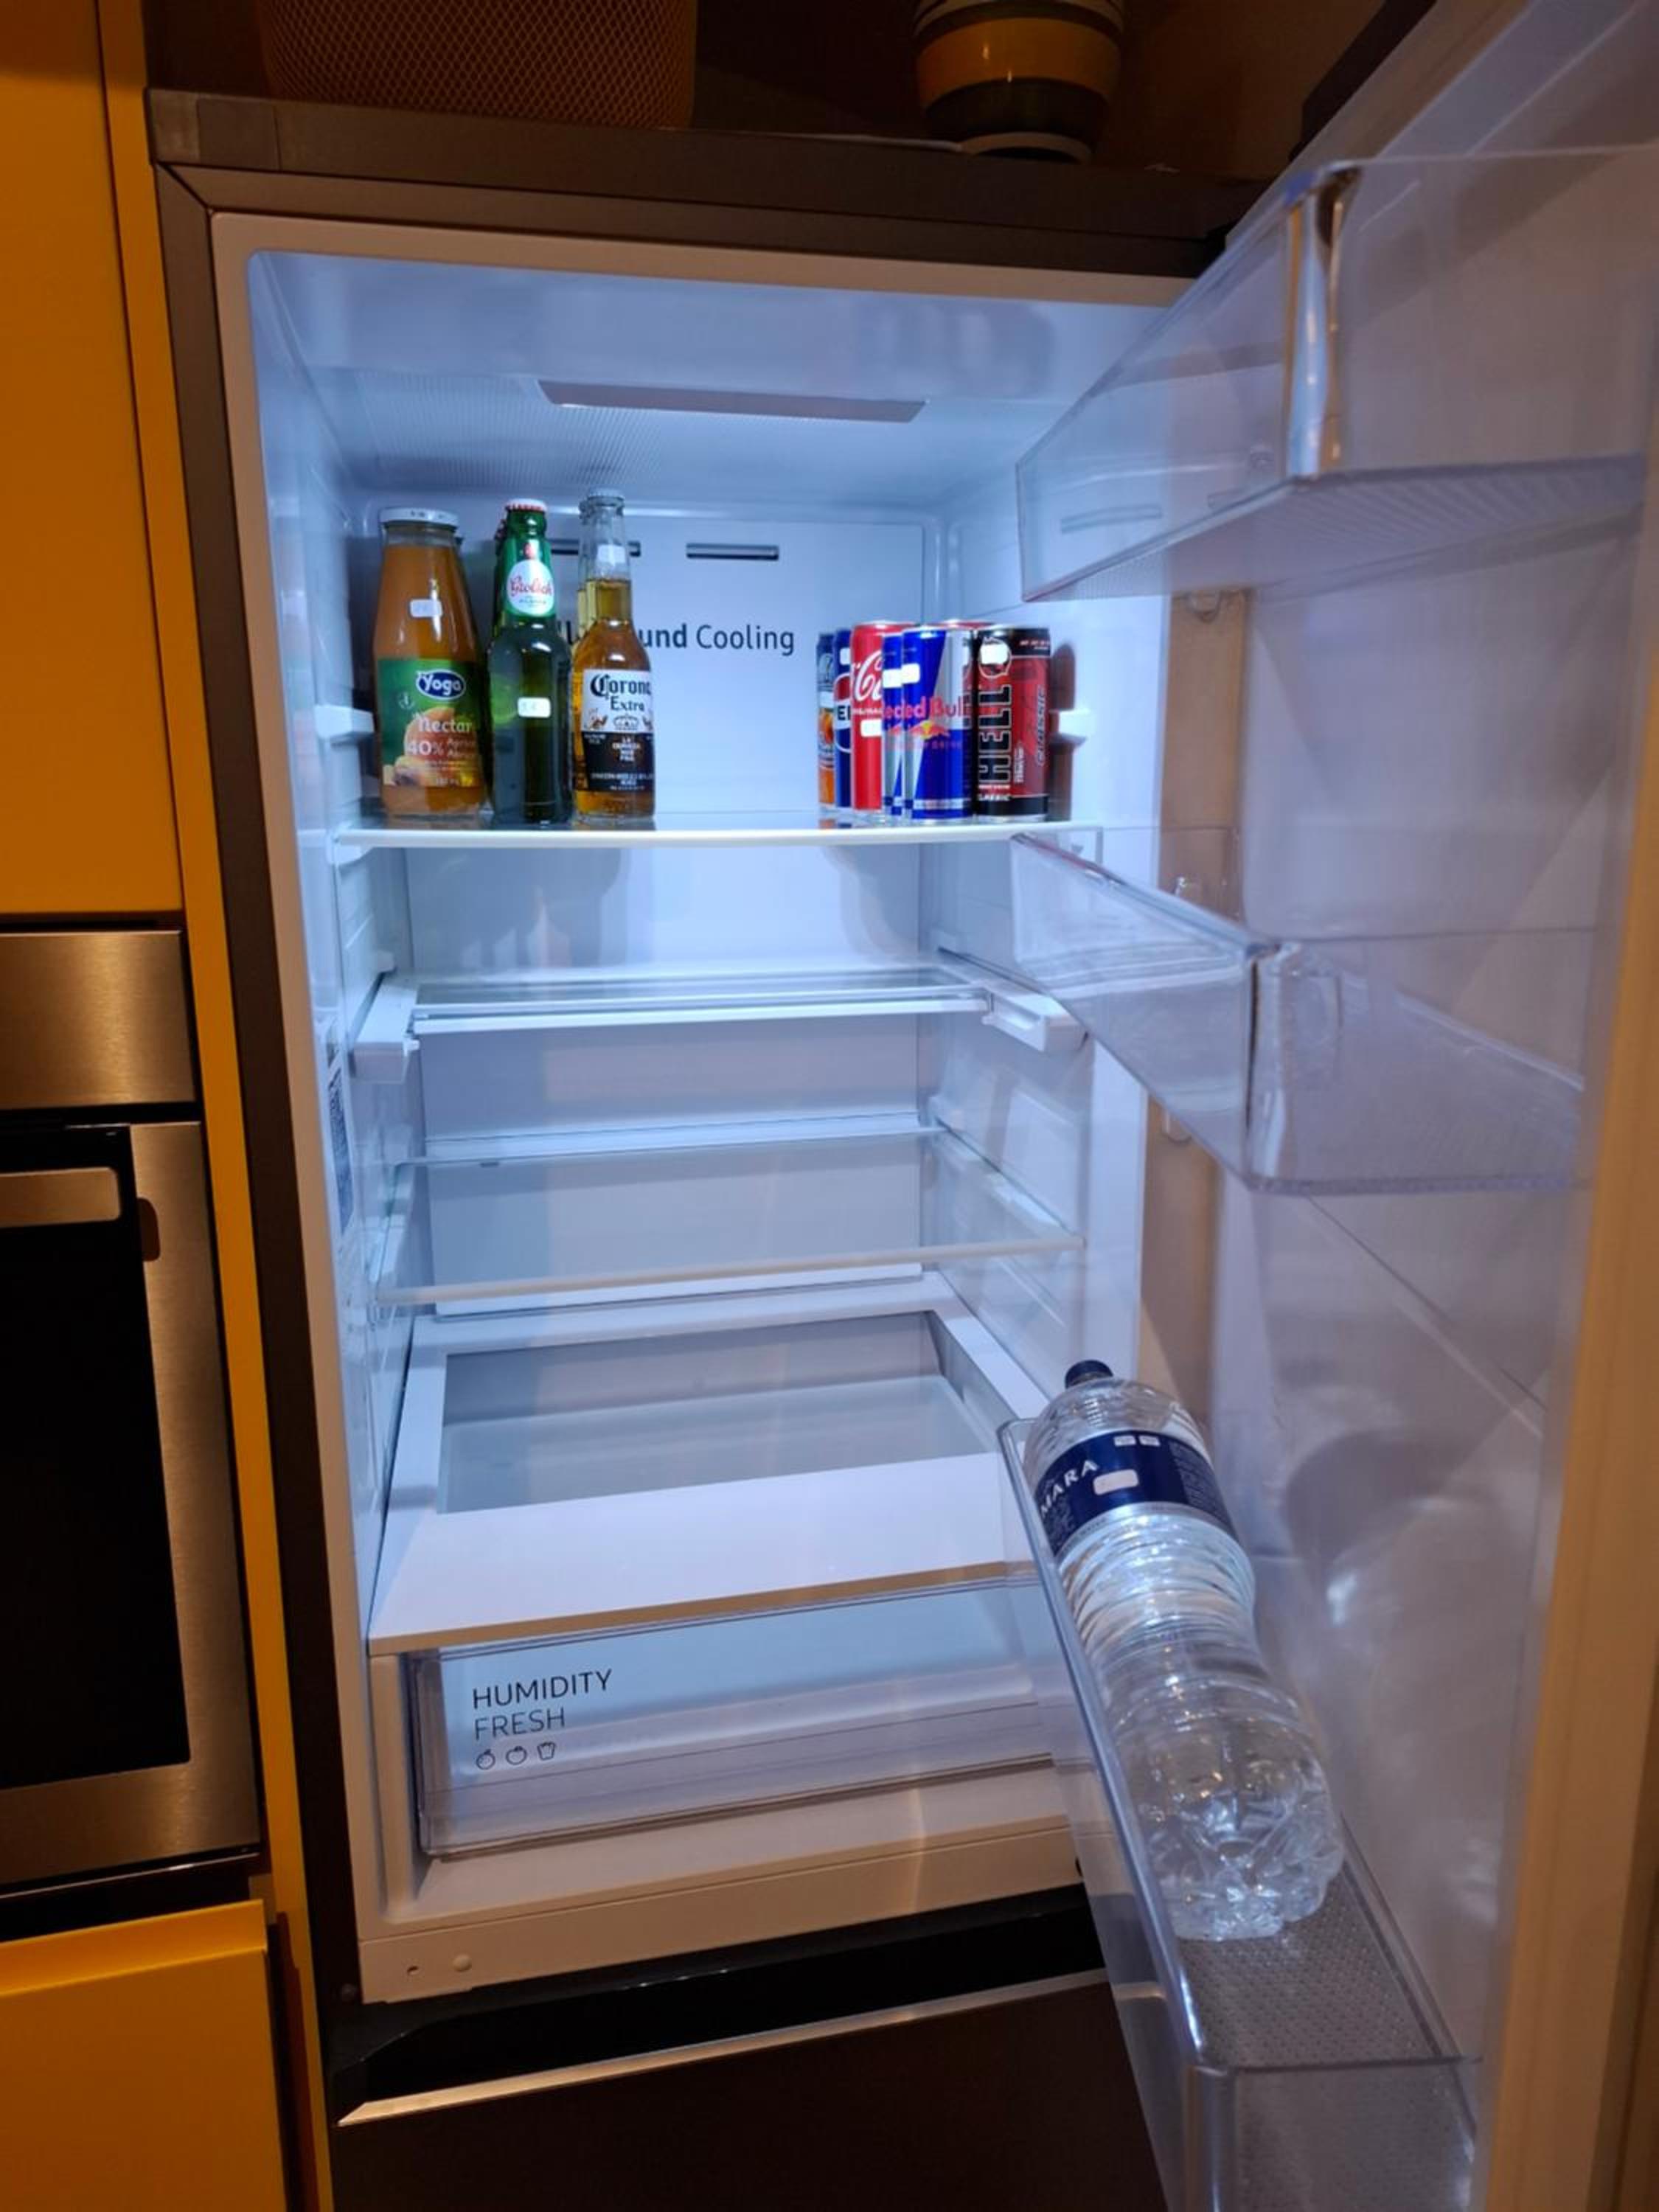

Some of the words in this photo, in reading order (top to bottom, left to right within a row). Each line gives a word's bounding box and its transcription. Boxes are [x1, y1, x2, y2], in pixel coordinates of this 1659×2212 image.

[509, 574, 552, 597] Grolsch
[638, 622, 687, 649] und
[696, 624, 795, 656] Cooling
[421, 672, 462, 696] Yoga
[610, 695, 645, 712] Extra
[978, 684, 1012, 785] HELL
[472, 1669, 612, 1710] HUMIDITY
[474, 1707, 566, 1741] FRESH
